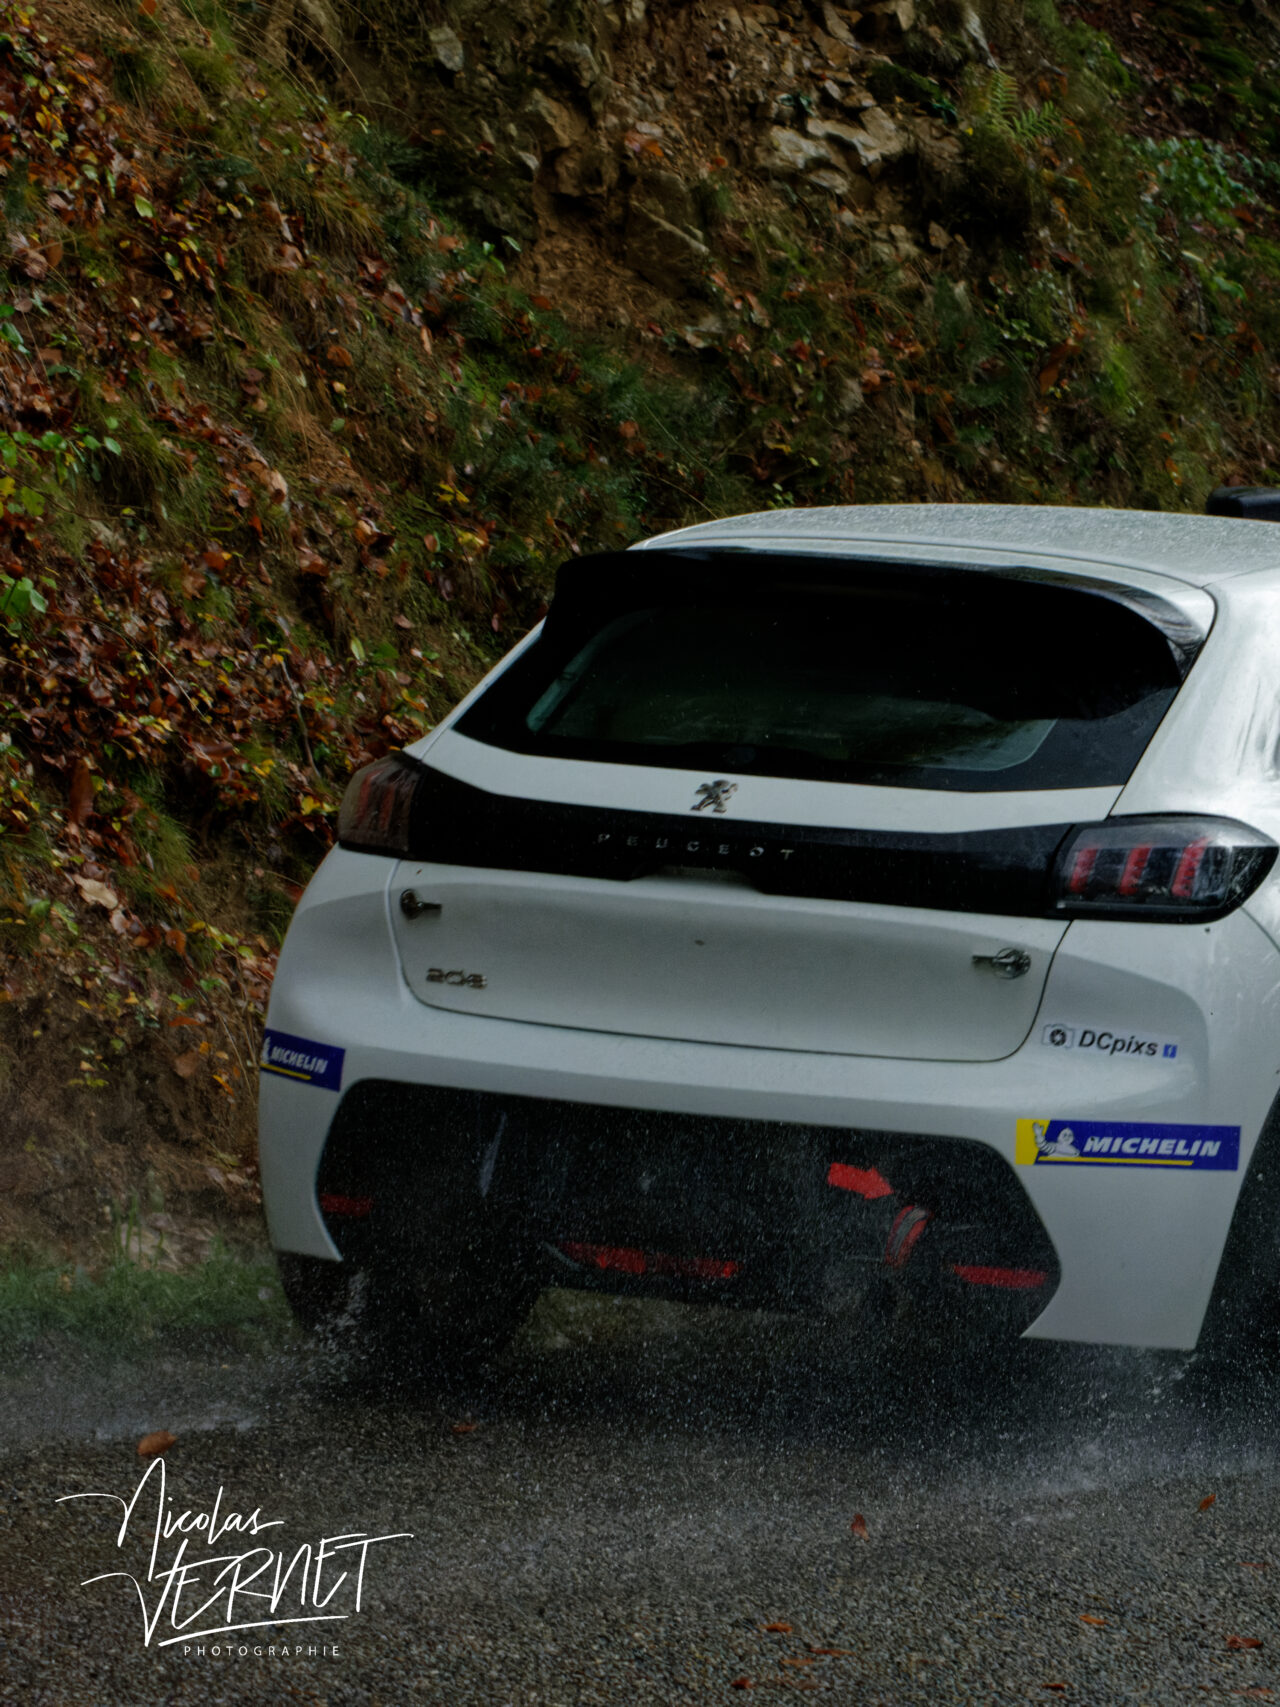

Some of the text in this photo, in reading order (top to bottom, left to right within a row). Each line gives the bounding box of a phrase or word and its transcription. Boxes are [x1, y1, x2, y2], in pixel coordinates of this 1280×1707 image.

[598, 833, 795, 860] PEUGEOT
[1078, 1029, 1159, 1056] DCpixs
[270, 1045, 329, 1075] MICHELIN
[1082, 1136, 1222, 1157] MICHELIN
